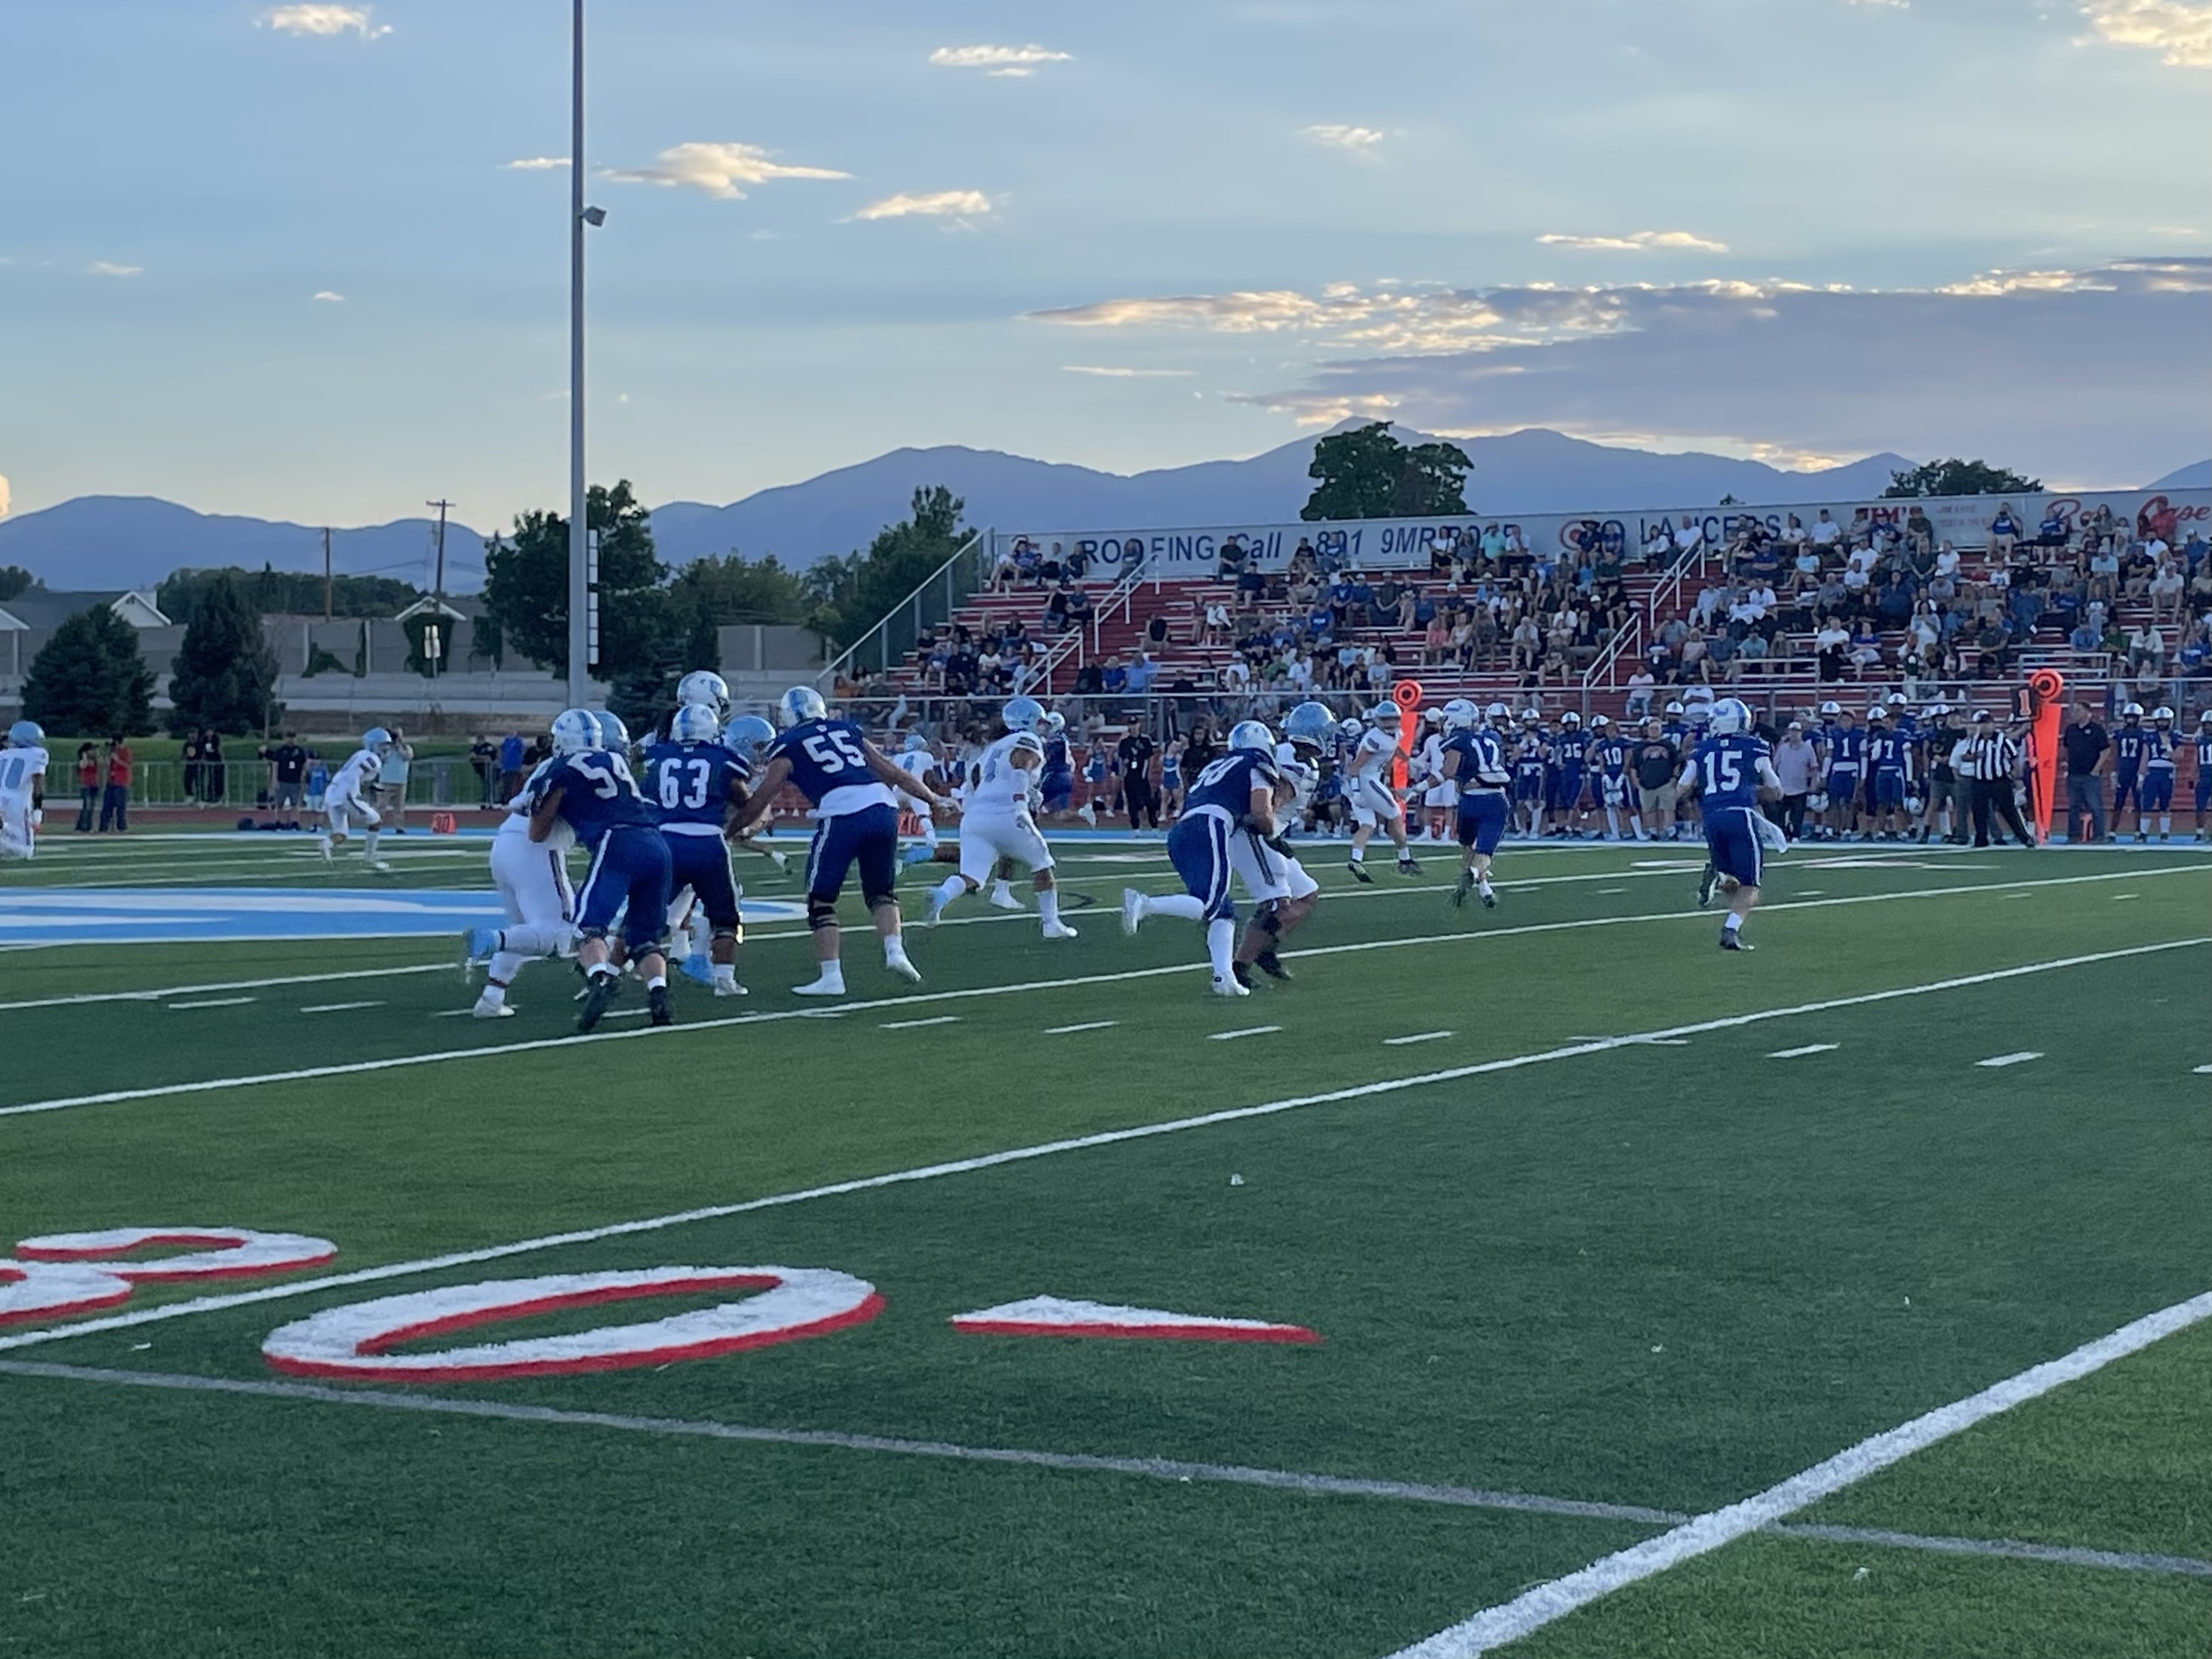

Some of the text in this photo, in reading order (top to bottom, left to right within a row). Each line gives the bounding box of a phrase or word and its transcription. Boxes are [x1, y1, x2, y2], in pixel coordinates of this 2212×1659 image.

[2019, 689, 2032, 716] 1
[802, 729, 866, 773] 55
[1603, 746, 1622, 765] 10
[2121, 737, 2138, 758] 17
[659, 758, 711, 809] 63
[1703, 750, 1743, 796] 15
